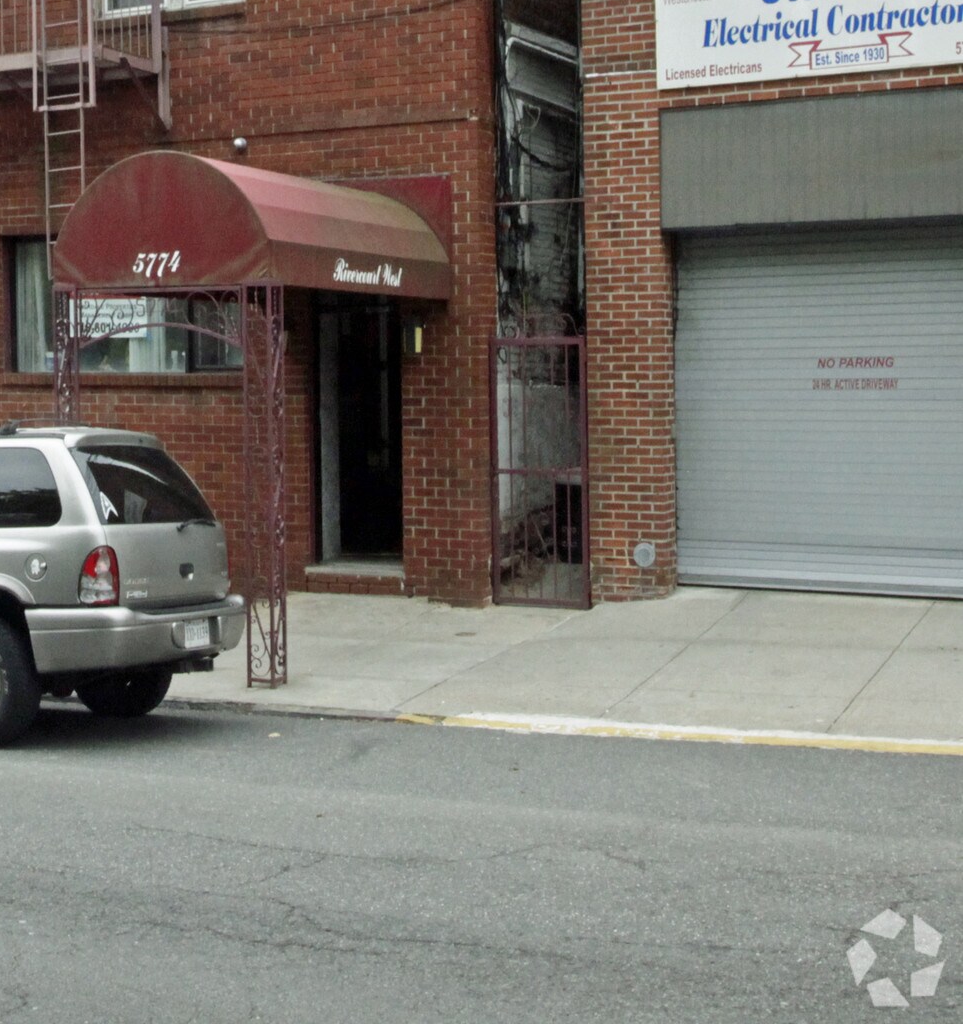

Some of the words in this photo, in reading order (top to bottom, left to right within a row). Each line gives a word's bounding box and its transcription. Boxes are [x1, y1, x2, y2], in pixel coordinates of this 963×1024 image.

[703, 7, 819, 48] Electrical
[815, 53, 832, 66] Est.
[835, 49, 860, 64] Since
[862, 47, 885, 61] 1930
[665, 65, 707, 81] Licensed
[132, 250, 181, 278] 5774
[333, 257, 382, 285] Rivercourt
[382, 263, 403, 287] West
[817, 357, 836, 368] NO
[838, 356, 895, 368] PARKING
[834, 378, 860, 390] ACTIVE
[861, 378, 899, 390] DRIVEWAY
